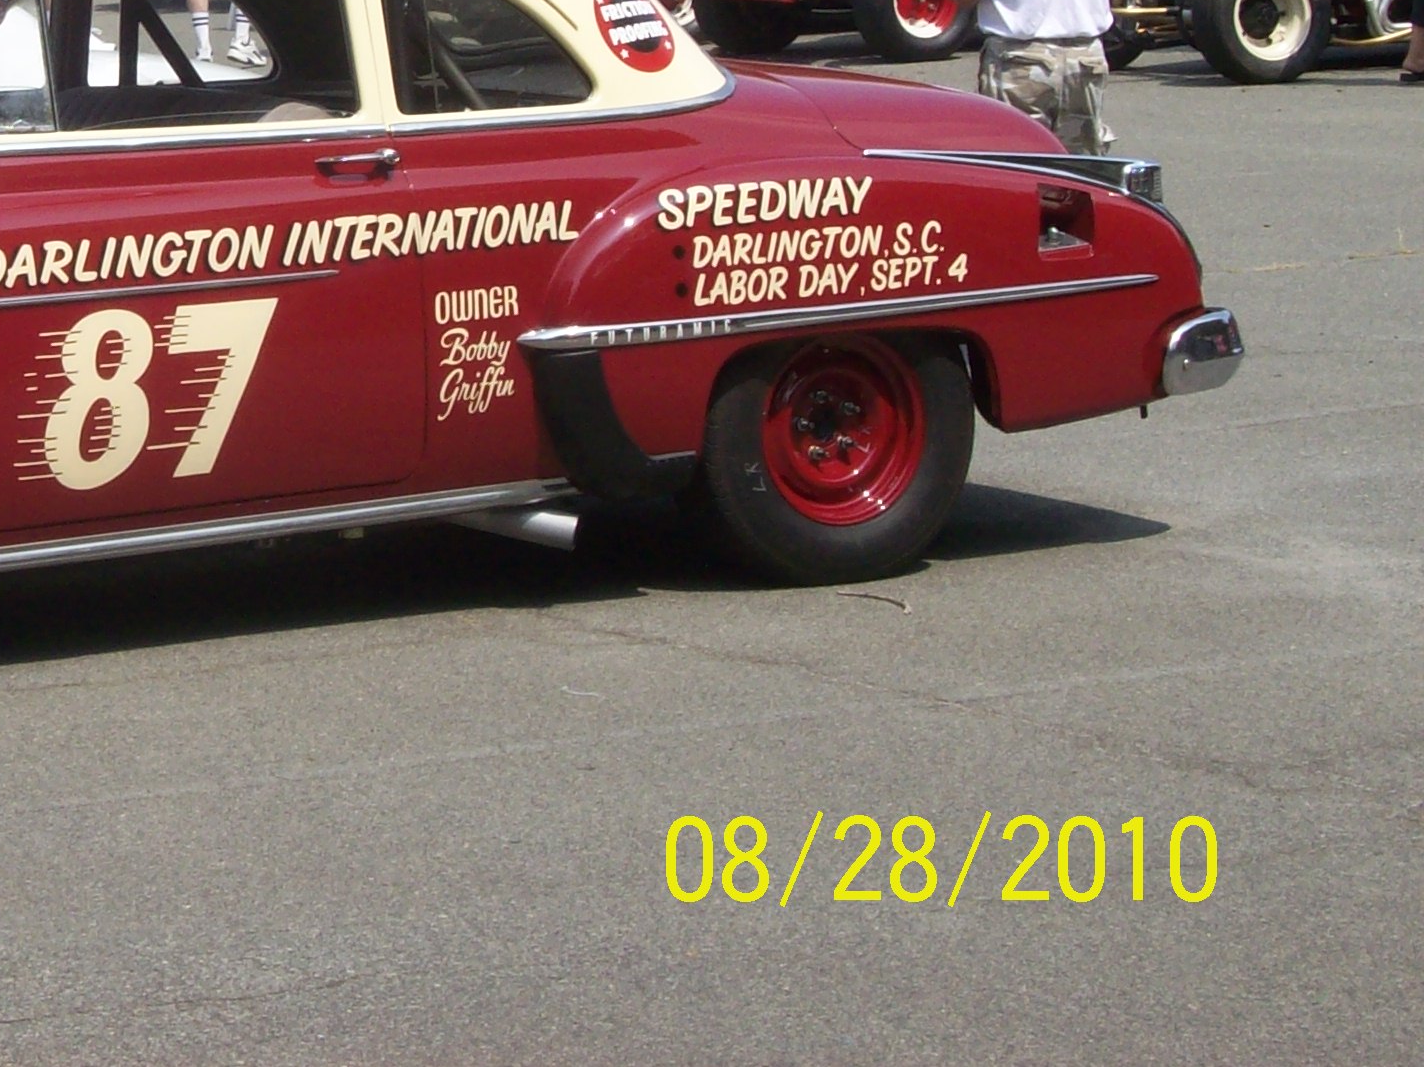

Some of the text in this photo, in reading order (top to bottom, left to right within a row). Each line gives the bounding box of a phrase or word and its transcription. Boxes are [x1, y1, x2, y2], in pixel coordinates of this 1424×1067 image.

[600, 0, 656, 22] FRICTION
[608, 20, 668, 46] PROOFING
[657, 175, 873, 231] SPEEDWAY
[282, 200, 579, 268] INTERNATIONAL
[893, 220, 945, 256] S.C.
[694, 266, 788, 307] LABOR
[870, 256, 941, 292] SEPT.
[947, 253, 968, 282] 4
[435, 285, 519, 325] OWNER
[439, 327, 511, 366] Bobby
[590, 318, 732, 345] FUTURAMIC
[42, 297, 278, 490] 87
[437, 366, 515, 421] Griffin
